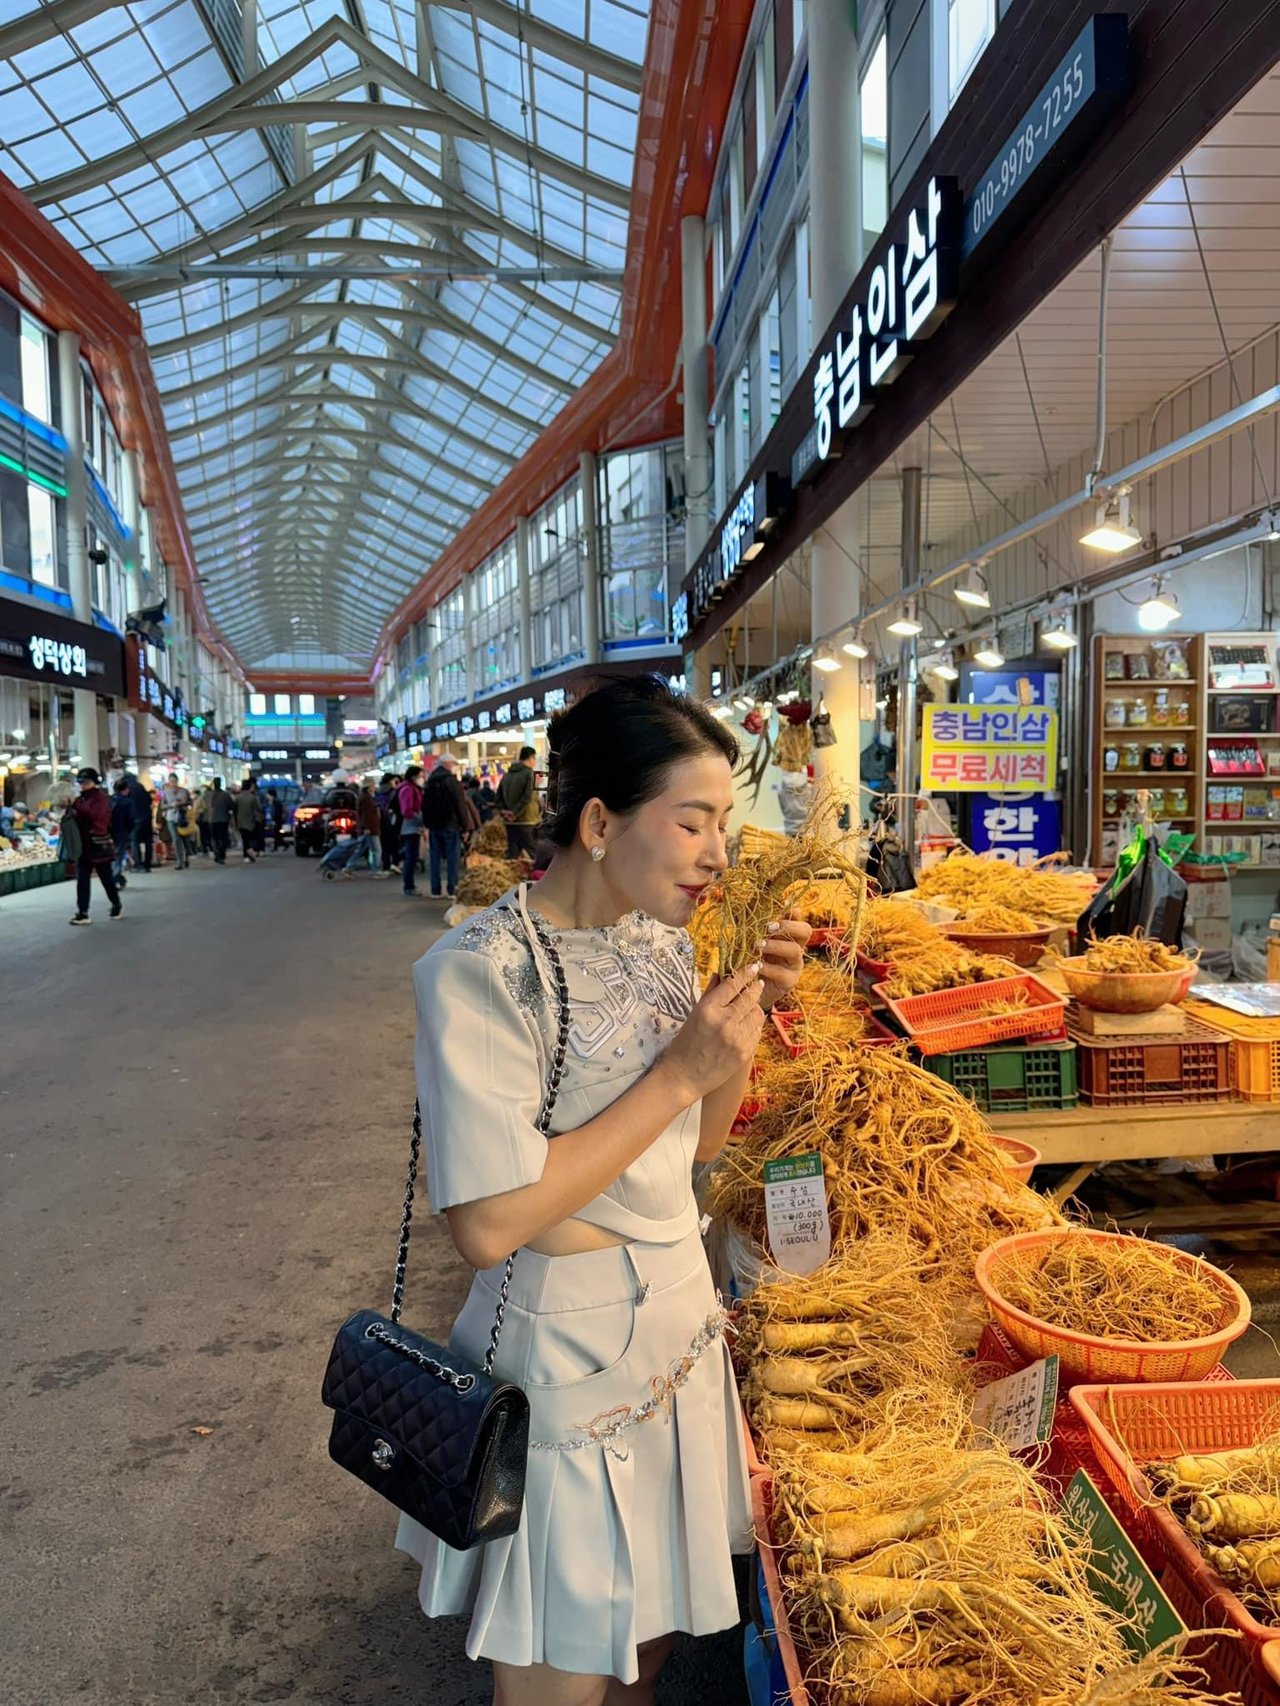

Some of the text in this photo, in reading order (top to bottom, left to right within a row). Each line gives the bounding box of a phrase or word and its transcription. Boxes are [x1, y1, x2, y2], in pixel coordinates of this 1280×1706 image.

[973, 52, 1083, 234] 010-9978-7255
[814, 175, 942, 460] 충남인삼
[29, 635, 87, 677] 성덕상회
[932, 711, 1050, 742] 충남인삼
[930, 754, 1046, 784] 무료세척
[1067, 1484, 1099, 1533] 원산지
[1111, 1548, 1158, 1632] 국내산
